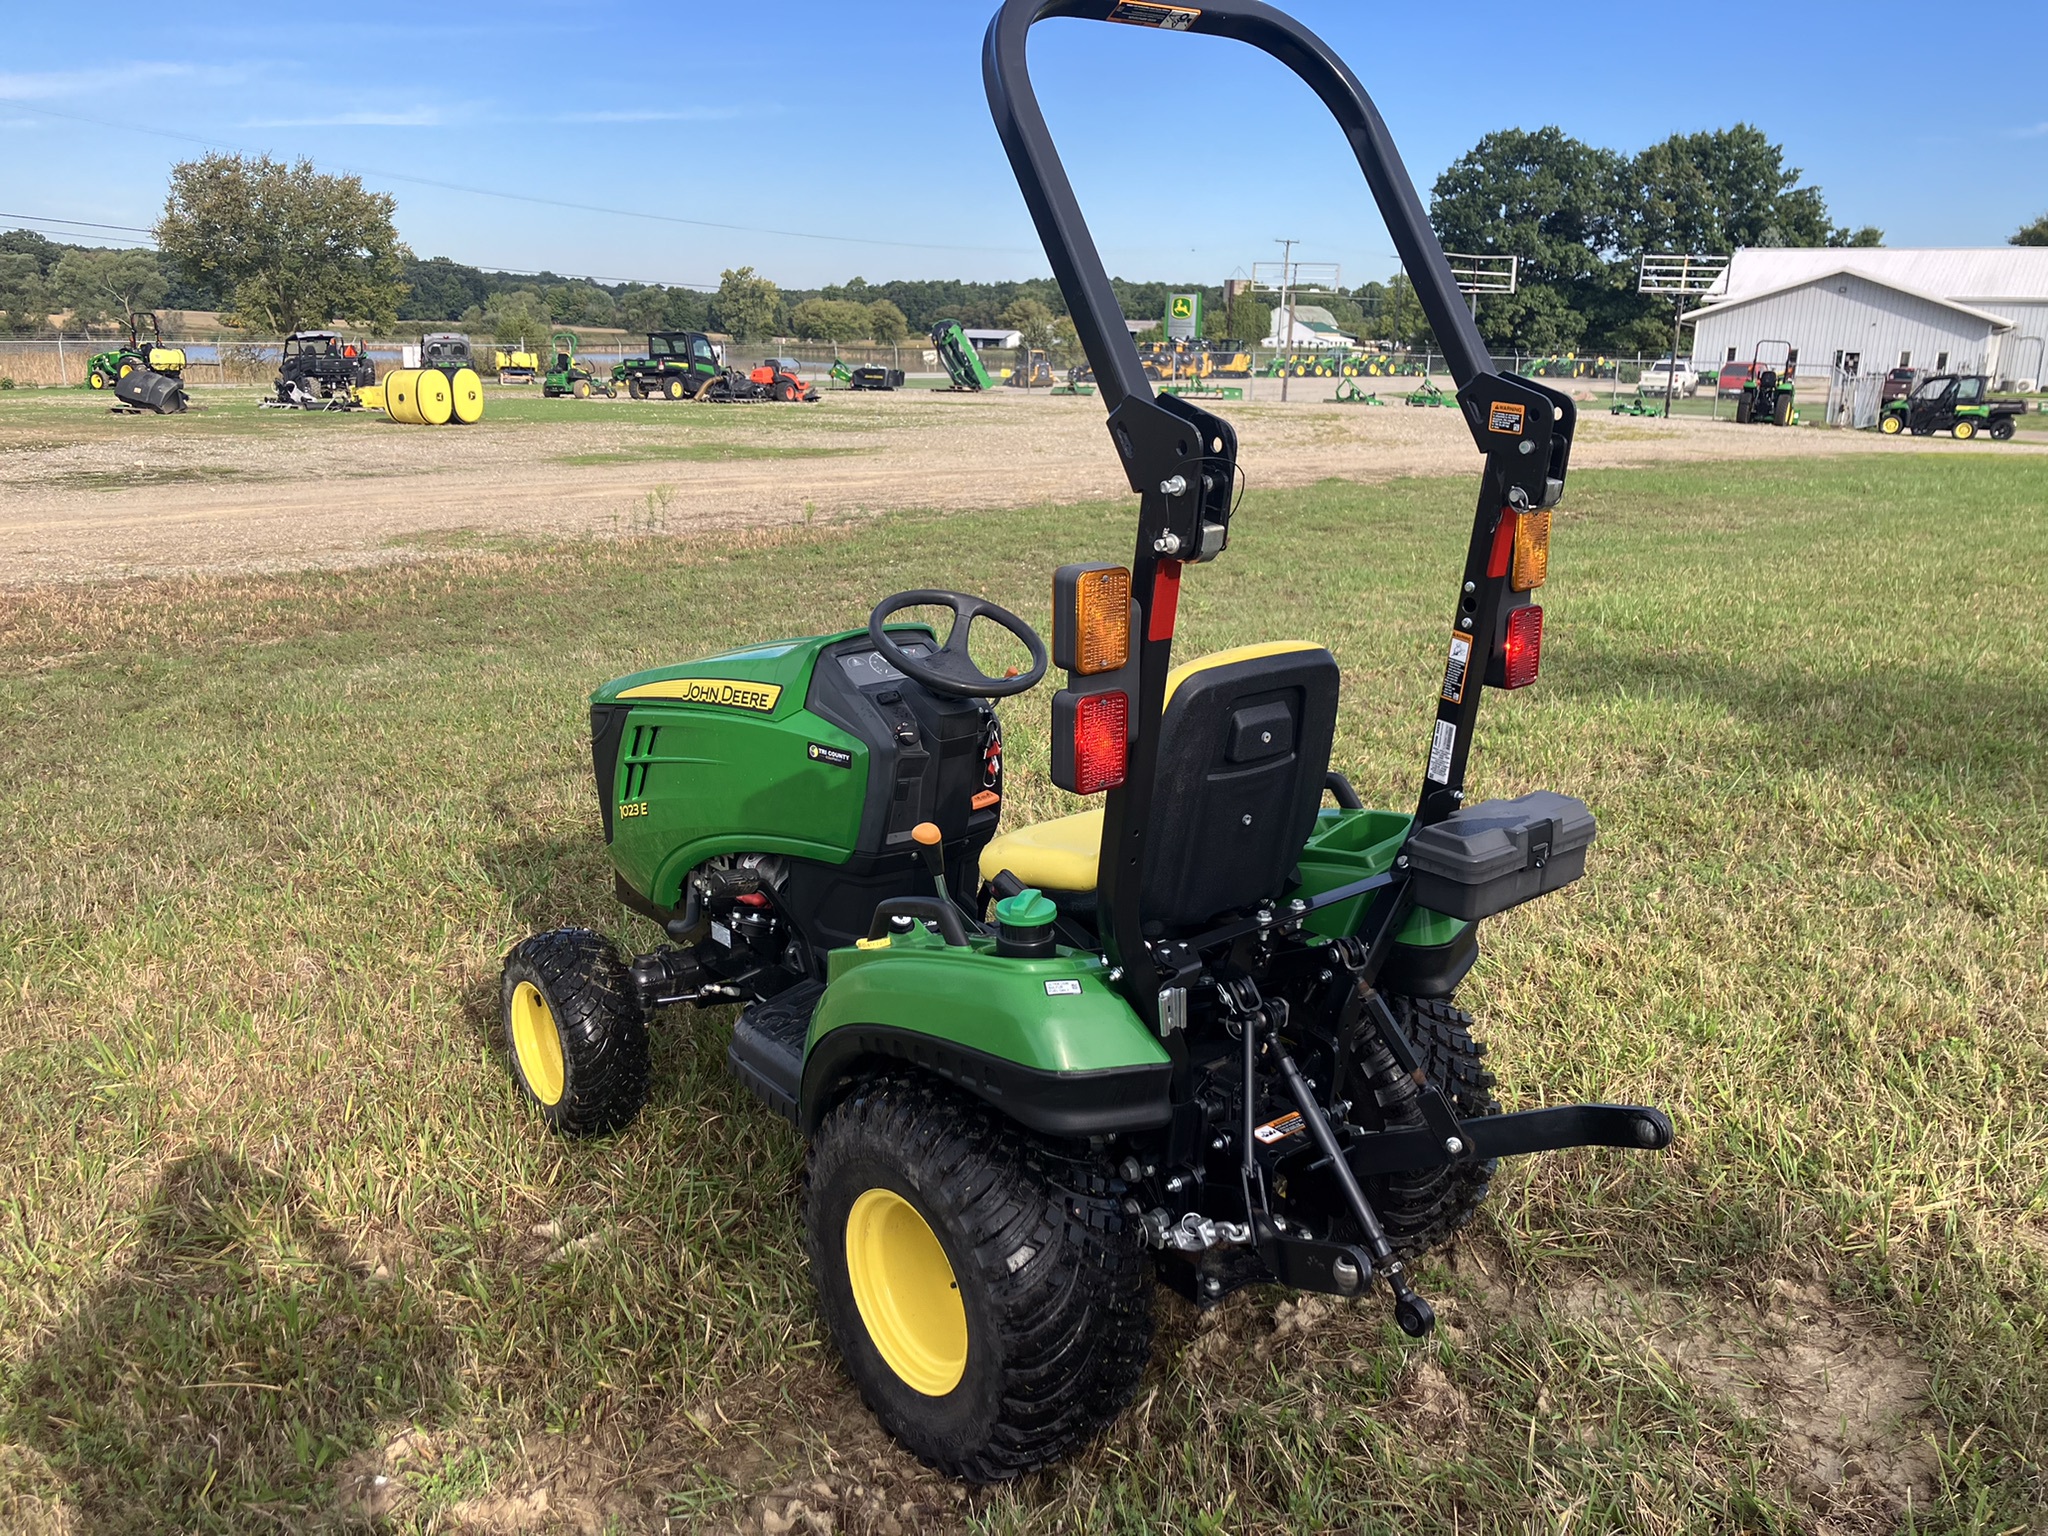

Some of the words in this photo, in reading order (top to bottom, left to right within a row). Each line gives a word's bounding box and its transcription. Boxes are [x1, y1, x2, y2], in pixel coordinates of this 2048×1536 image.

[682, 682, 720, 701] JOHN
[721, 685, 769, 707] DEERE
[818, 747, 828, 756] TRI
[827, 750, 850, 761] COUNTY
[619, 803, 639, 820] 1023
[640, 802, 648, 815] E
